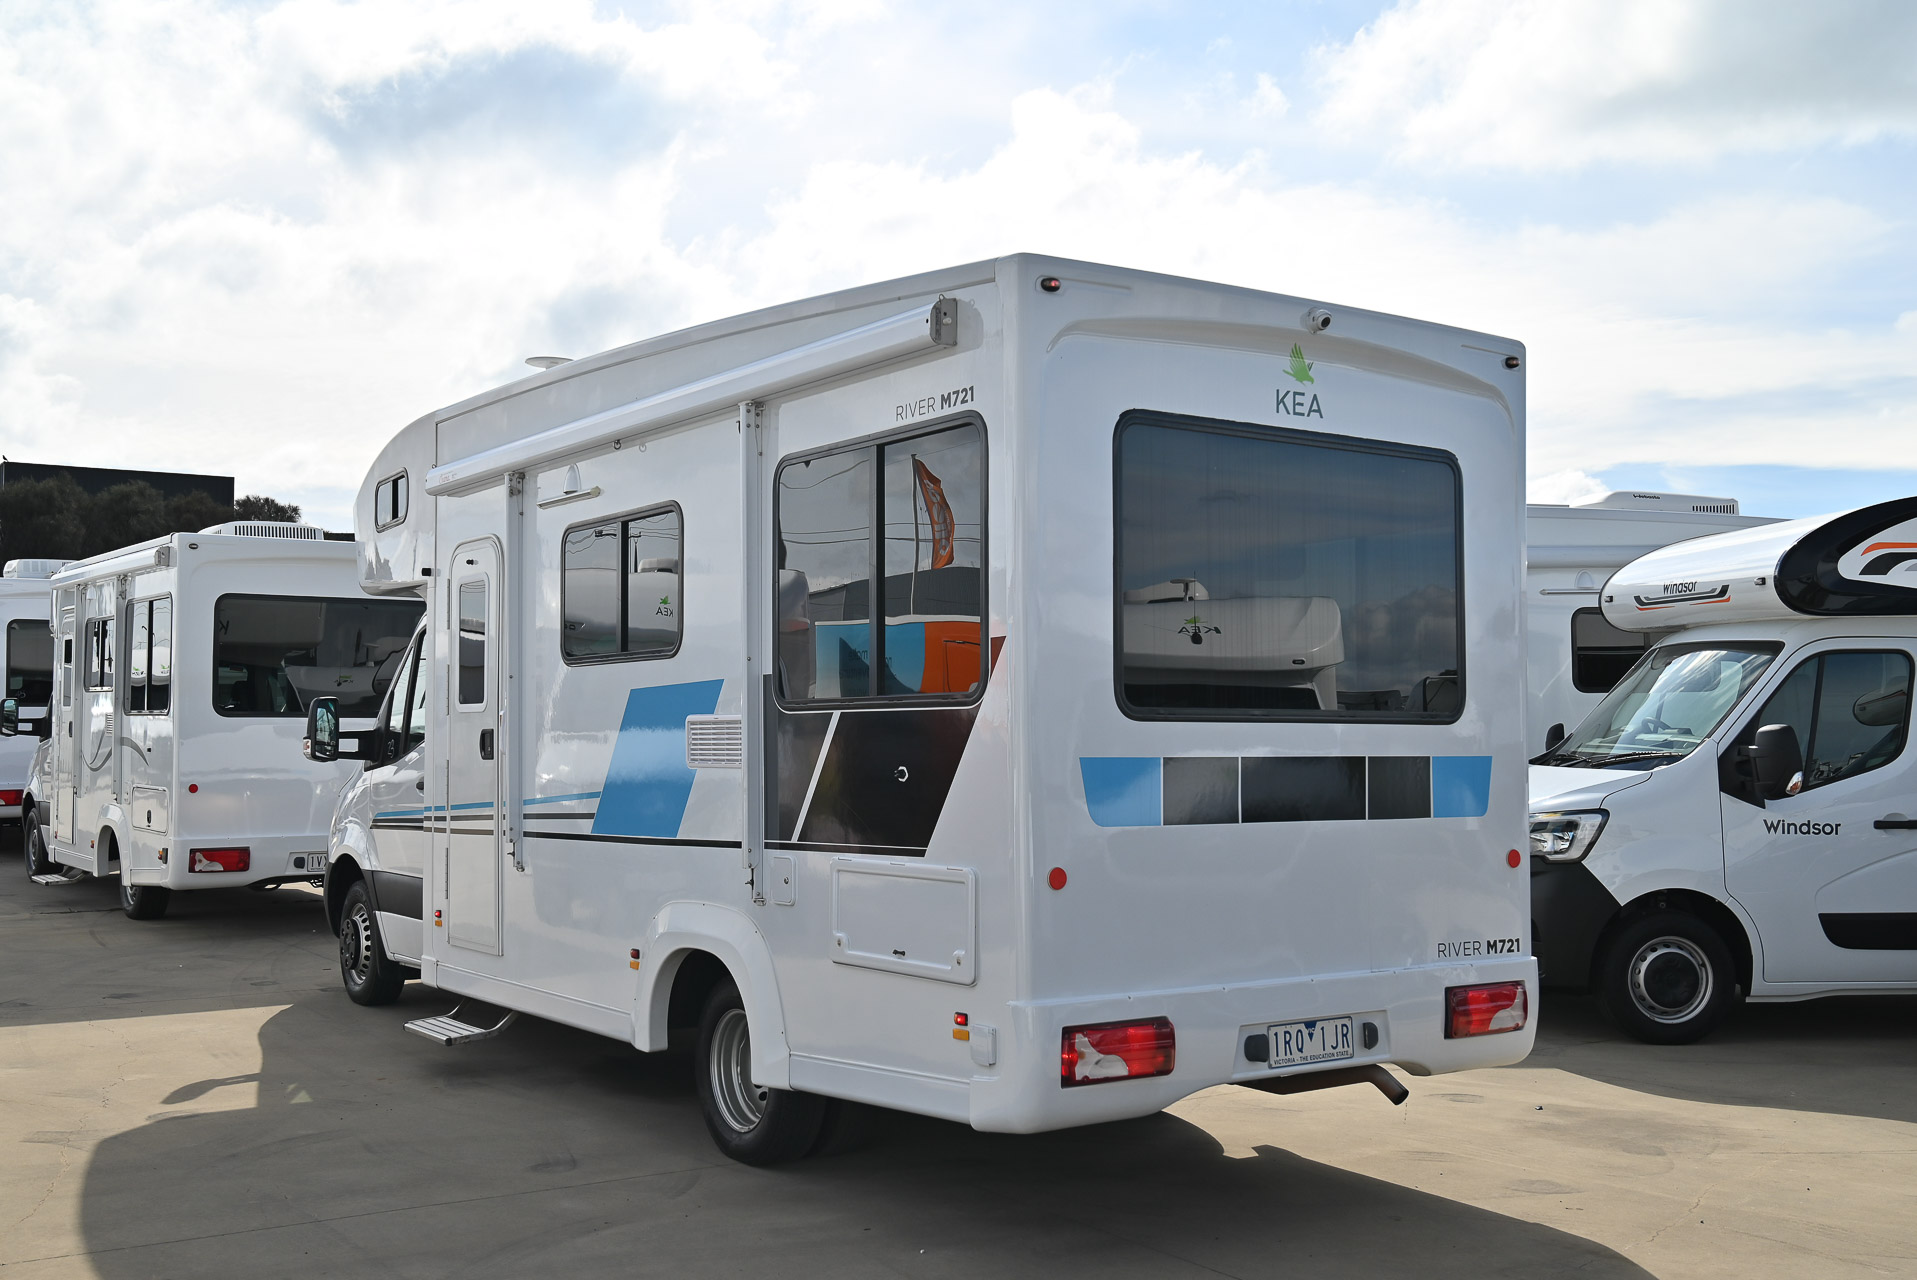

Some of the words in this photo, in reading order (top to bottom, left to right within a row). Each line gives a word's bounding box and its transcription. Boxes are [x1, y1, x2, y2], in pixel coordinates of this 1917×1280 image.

[896, 396, 936, 422] RIVER
[940, 385, 975, 410] M721
[1276, 388, 1324, 419] KEA
[1762, 819, 1842, 836] Windsor
[1437, 940, 1482, 958] RIVER
[1486, 938, 1520, 955] M721
[1274, 1029, 1304, 1057] 1RQ
[1321, 1024, 1350, 1051] 1JR
[1273, 1057, 1296, 1066] VICTORIA
[1299, 1055, 1309, 1063] THE
[1310, 1053, 1335, 1061] EDUCATION
